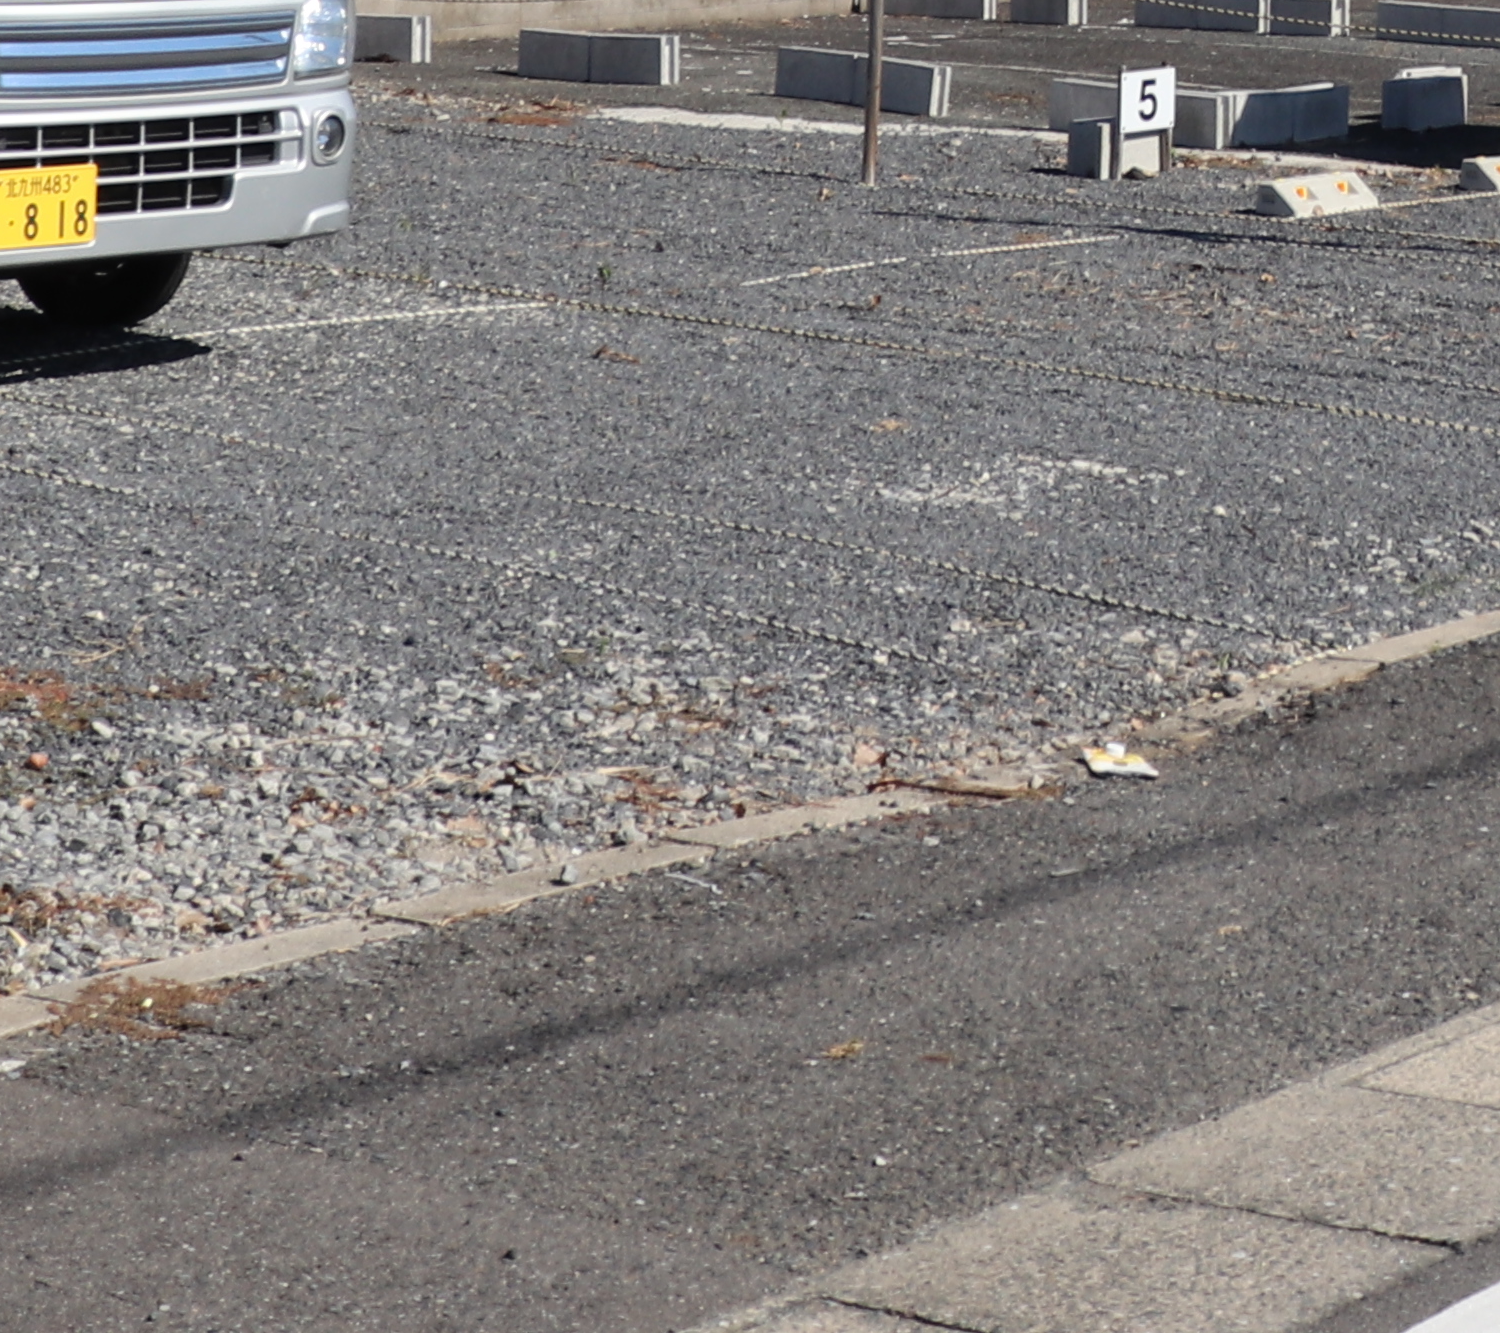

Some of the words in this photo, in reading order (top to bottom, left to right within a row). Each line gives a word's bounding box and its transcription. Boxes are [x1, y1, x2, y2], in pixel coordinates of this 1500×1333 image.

[1138, 78, 1158, 122] 5
[5, 174, 72, 199] 北九州483
